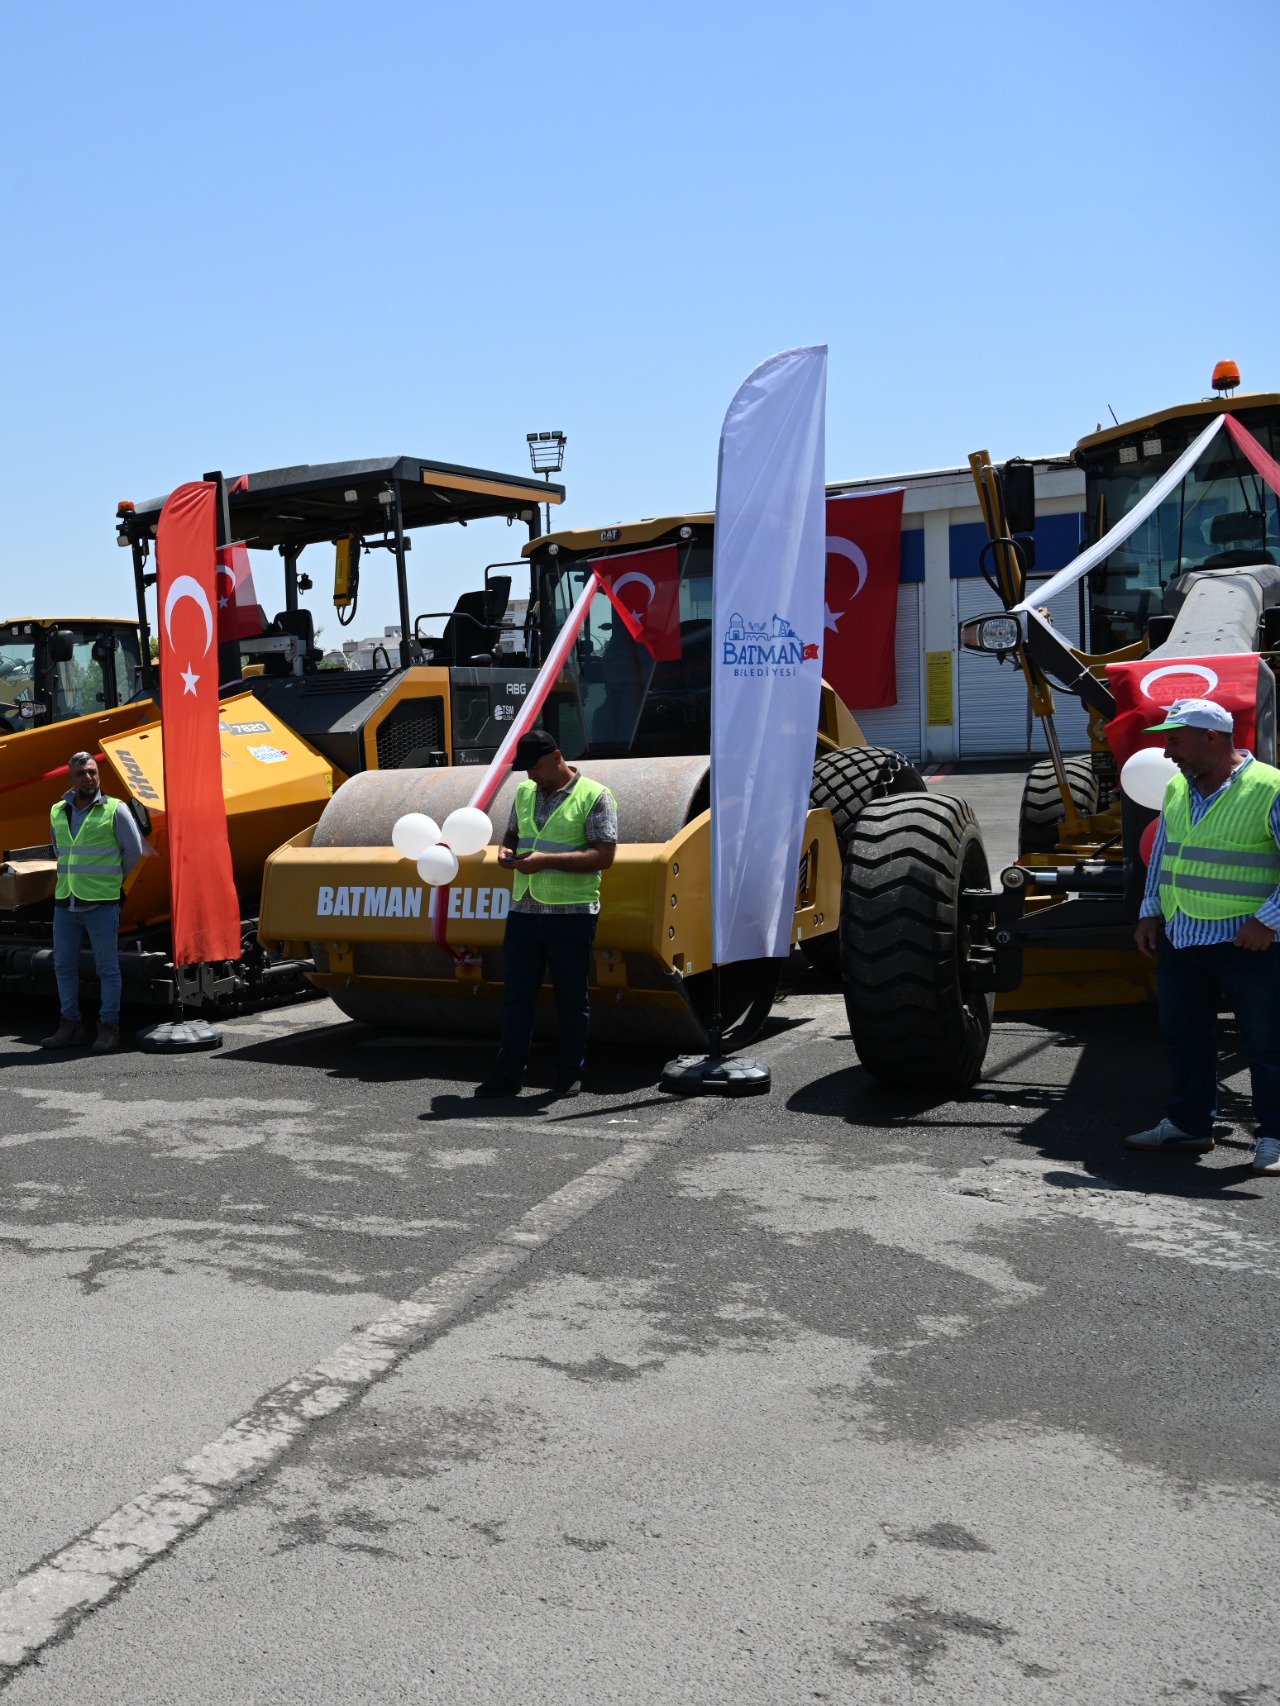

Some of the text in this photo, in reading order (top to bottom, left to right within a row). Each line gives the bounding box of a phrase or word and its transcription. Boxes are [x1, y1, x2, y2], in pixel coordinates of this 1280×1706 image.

[601, 529, 618, 541] CAT
[723, 642, 805, 665] BATMAN
[734, 667, 796, 676] BELEDİYESİ
[506, 683, 527, 695] ABG
[502, 705, 515, 715] TSM
[233, 723, 267, 734] 7820
[115, 749, 160, 800] titan
[317, 886, 423, 917] BATMAN
